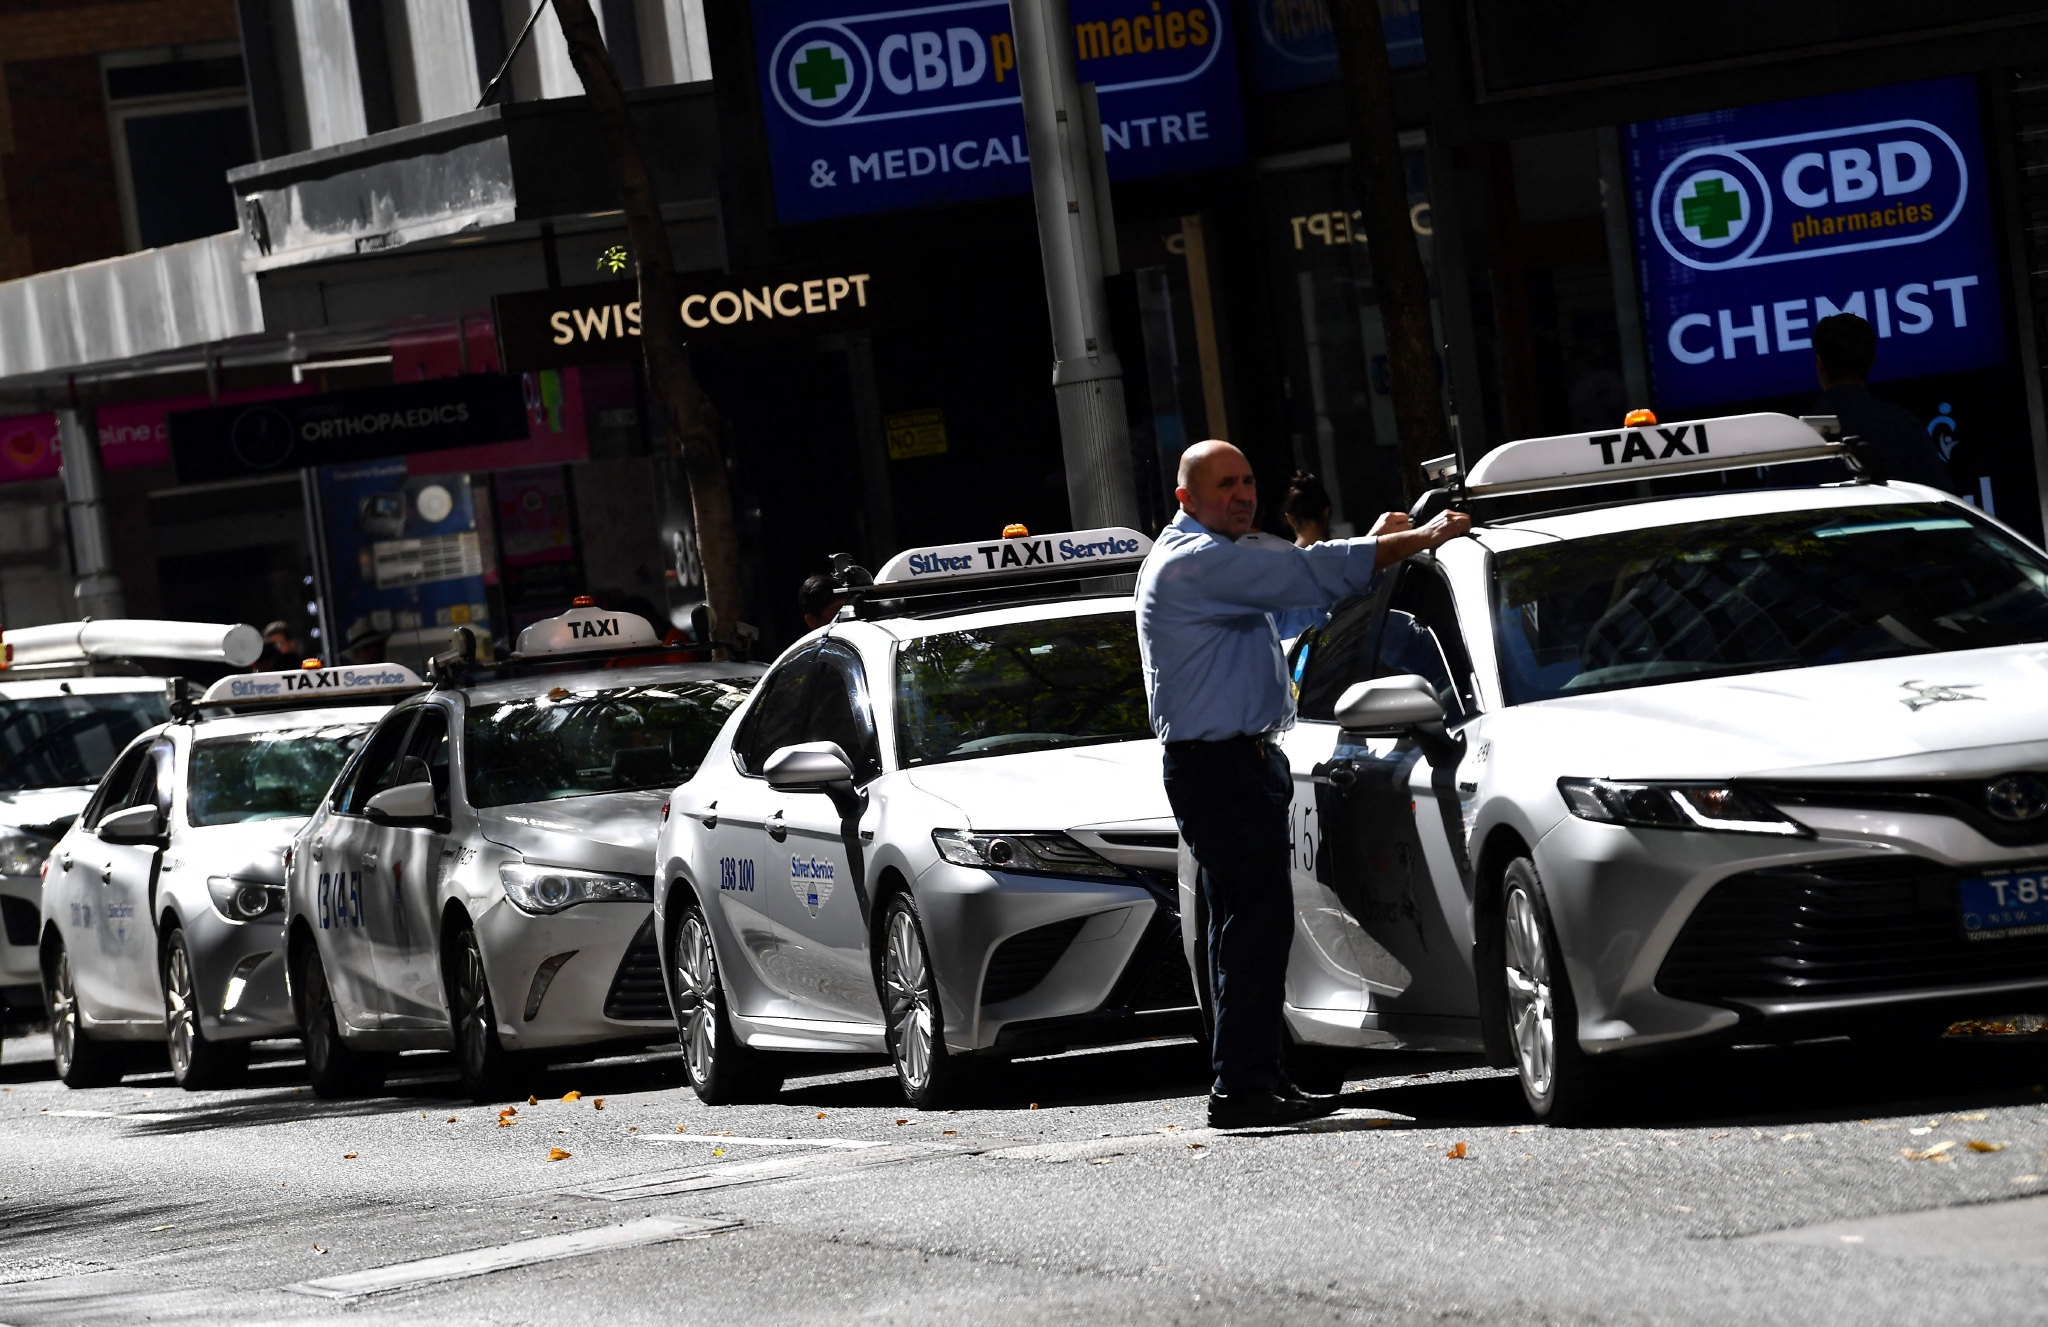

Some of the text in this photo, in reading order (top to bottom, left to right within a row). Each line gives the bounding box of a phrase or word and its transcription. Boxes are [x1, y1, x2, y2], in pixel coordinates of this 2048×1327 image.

[878, 27, 987, 95] CBD
[990, 1, 1209, 82] pmacies
[809, 110, 1210, 188] & MEDICAL NTRE
[1781, 140, 1933, 208] CBD
[1791, 202, 1934, 244] pharmacies
[550, 273, 871, 346] SWIS CONCEPT
[300, 401, 471, 442] ORTHOPAEDICS
[1590, 425, 1710, 465] TAXI
[909, 537, 1139, 576] Silver TAXI Service
[568, 619, 618, 638] TAXI
[231, 670, 405, 696] Silver TAXI Service
[720, 856, 754, 892] 133 100
[791, 856, 834, 880] Silver Service
[318, 872, 330, 929] 13
[350, 870, 364, 927] 51
